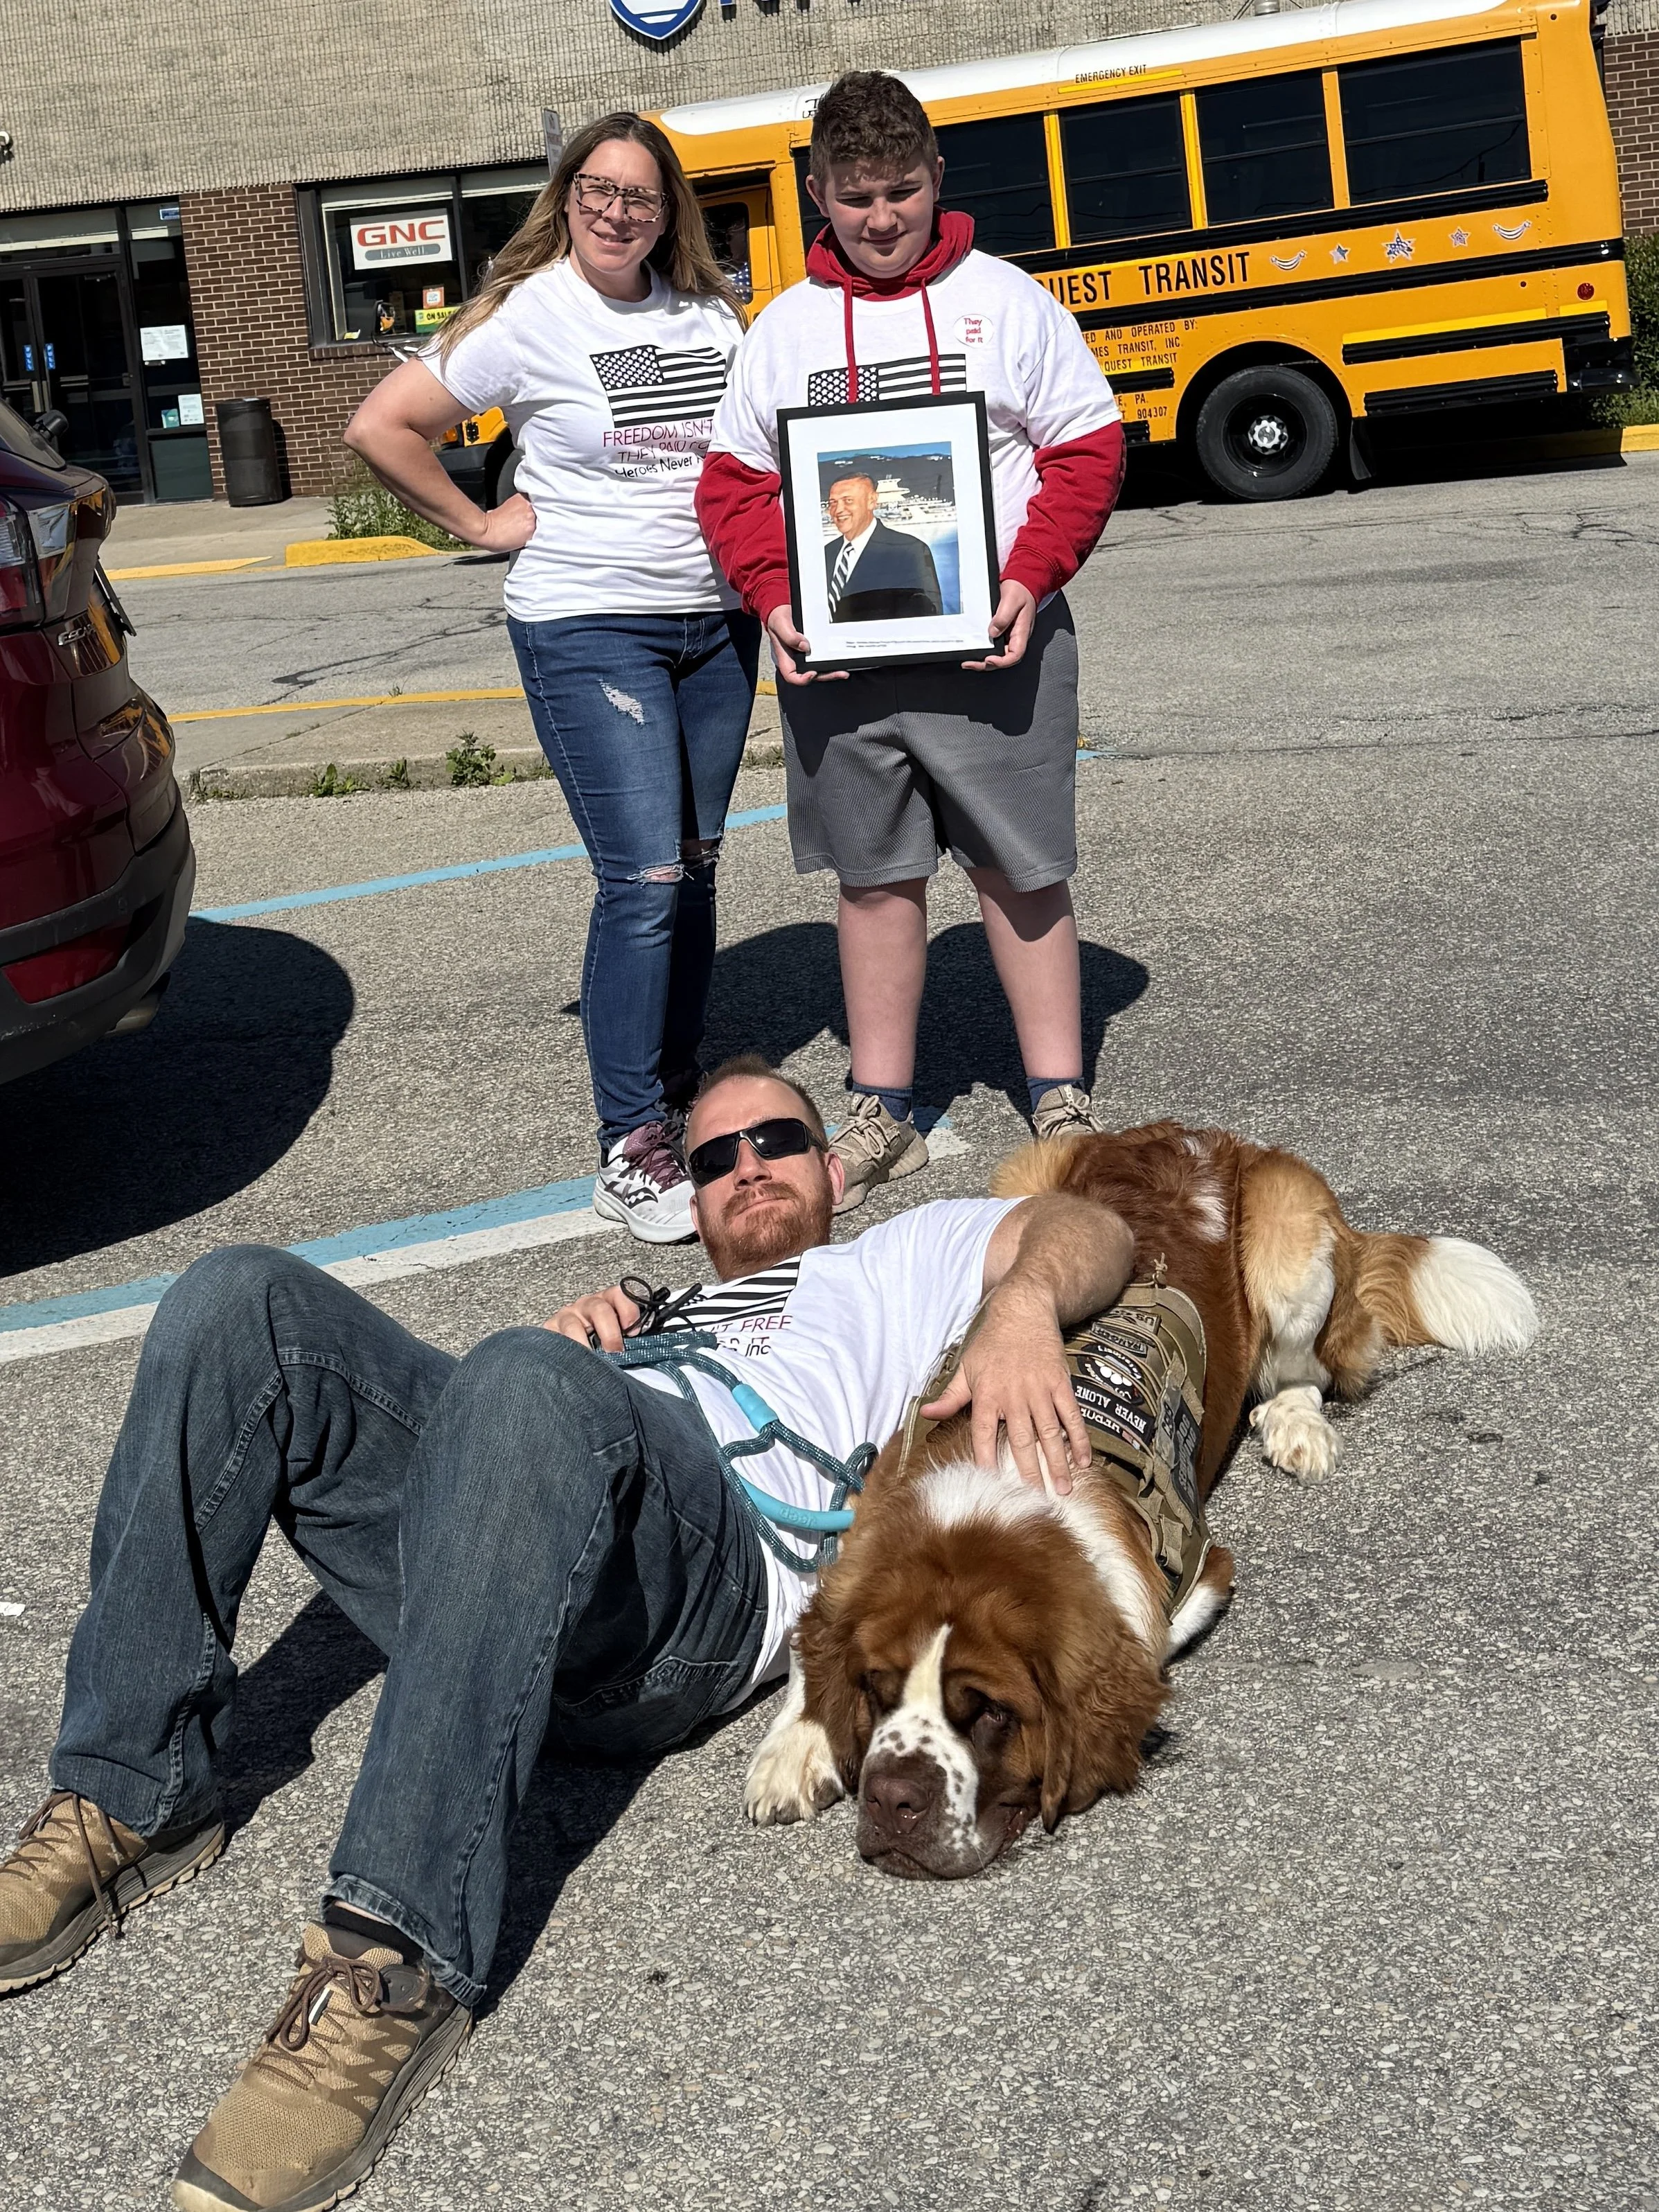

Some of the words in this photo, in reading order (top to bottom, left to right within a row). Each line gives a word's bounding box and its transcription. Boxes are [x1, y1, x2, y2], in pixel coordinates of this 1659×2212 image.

[1075, 67, 1126, 83] EMERGENCY
[1129, 64, 1146, 75] EXIT
[357, 220, 445, 247] GNC
[380, 249, 402, 259] Live
[1138, 251, 1250, 295] TRANSIT
[964, 317, 982, 326] They
[1082, 333, 1096, 344] ED
[1106, 328, 1122, 341] AND
[1131, 321, 1176, 337] OPERATED
[1104, 358, 1132, 372] QUEST
[1141, 352, 1178, 367] TRANSIT
[1137, 406, 1167, 419] 904307
[603, 424, 677, 448] FREEDOM
[682, 418, 713, 438] ISN'T
[618, 444, 656, 463] THEY
[659, 456, 692, 472] Never
[739, 1316, 793, 1333] FREE
[745, 1344, 771, 1357] Inc
[1074, 1385, 1111, 1408] ALONE
[1115, 1404, 1147, 1433] NEVER
